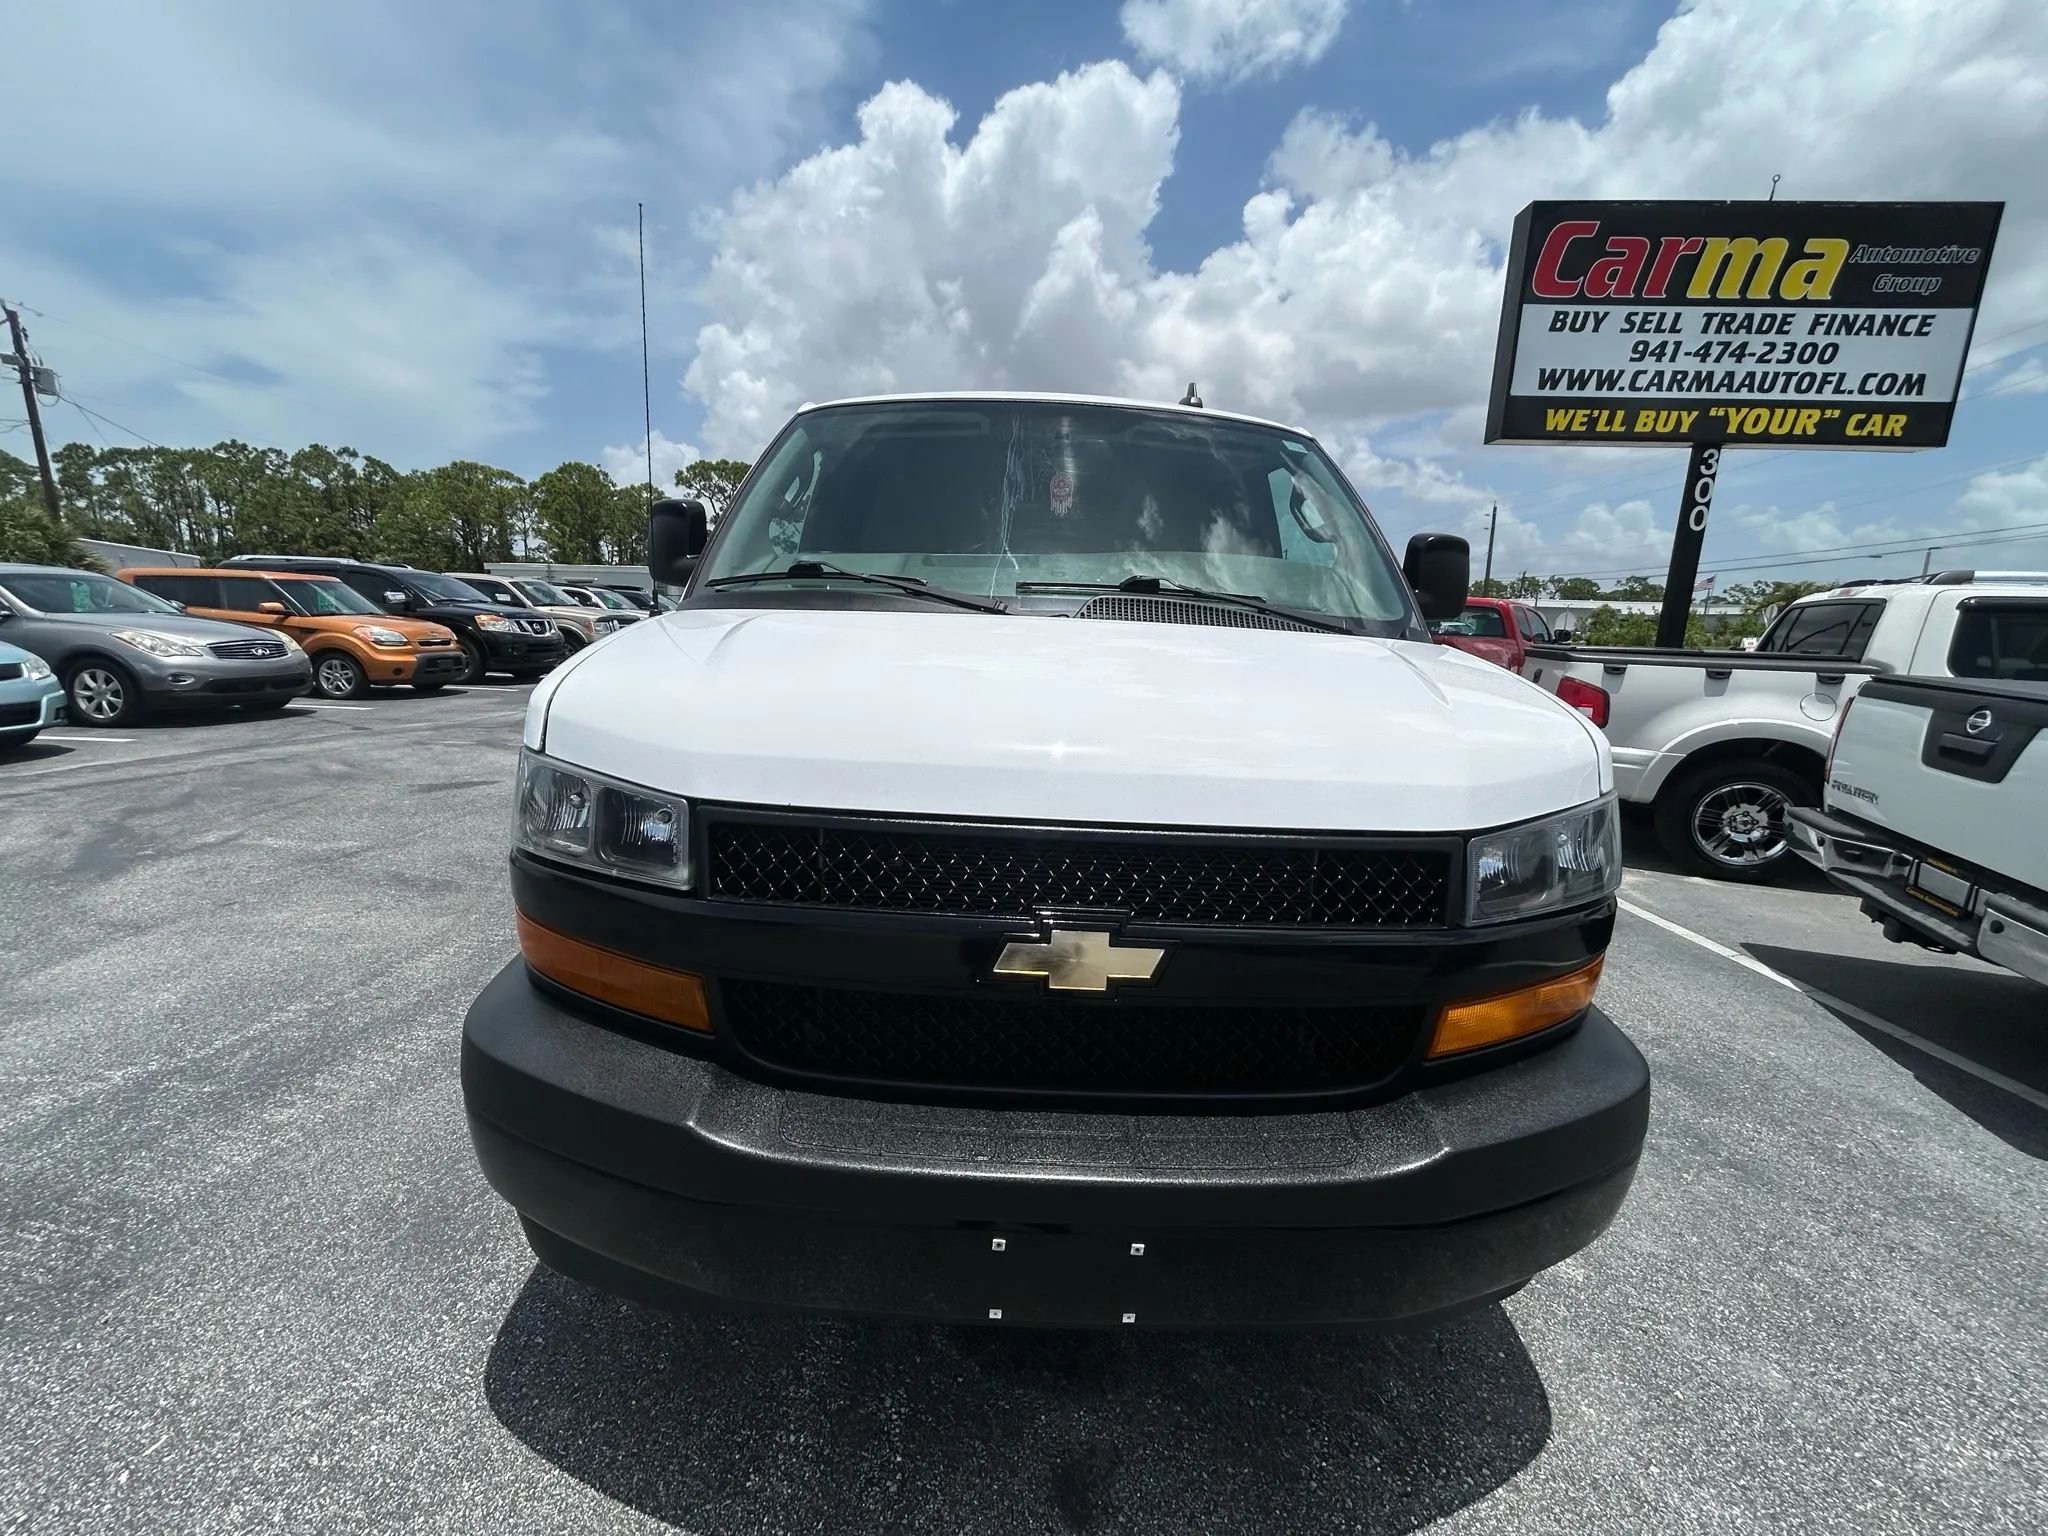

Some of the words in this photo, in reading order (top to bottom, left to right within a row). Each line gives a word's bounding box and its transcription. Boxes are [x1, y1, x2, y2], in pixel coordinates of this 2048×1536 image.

[1532, 221, 1850, 300] Carma
[1848, 245, 1981, 264] Automotive
[1872, 274, 1942, 296] Group
[1548, 310, 1610, 333] BUY
[1619, 311, 1683, 334] SELL
[1700, 312, 1796, 335] TRADE
[1807, 313, 1937, 337] FINANCE
[1628, 340, 1840, 365] 941-474-2300
[1537, 368, 1927, 396] WWW.CARMAAUTOFL.COM
[1545, 408, 1627, 432] WE'LL
[1634, 410, 1699, 433] BUY
[1845, 413, 1907, 437] CAR
[1689, 448, 1720, 532] 300
